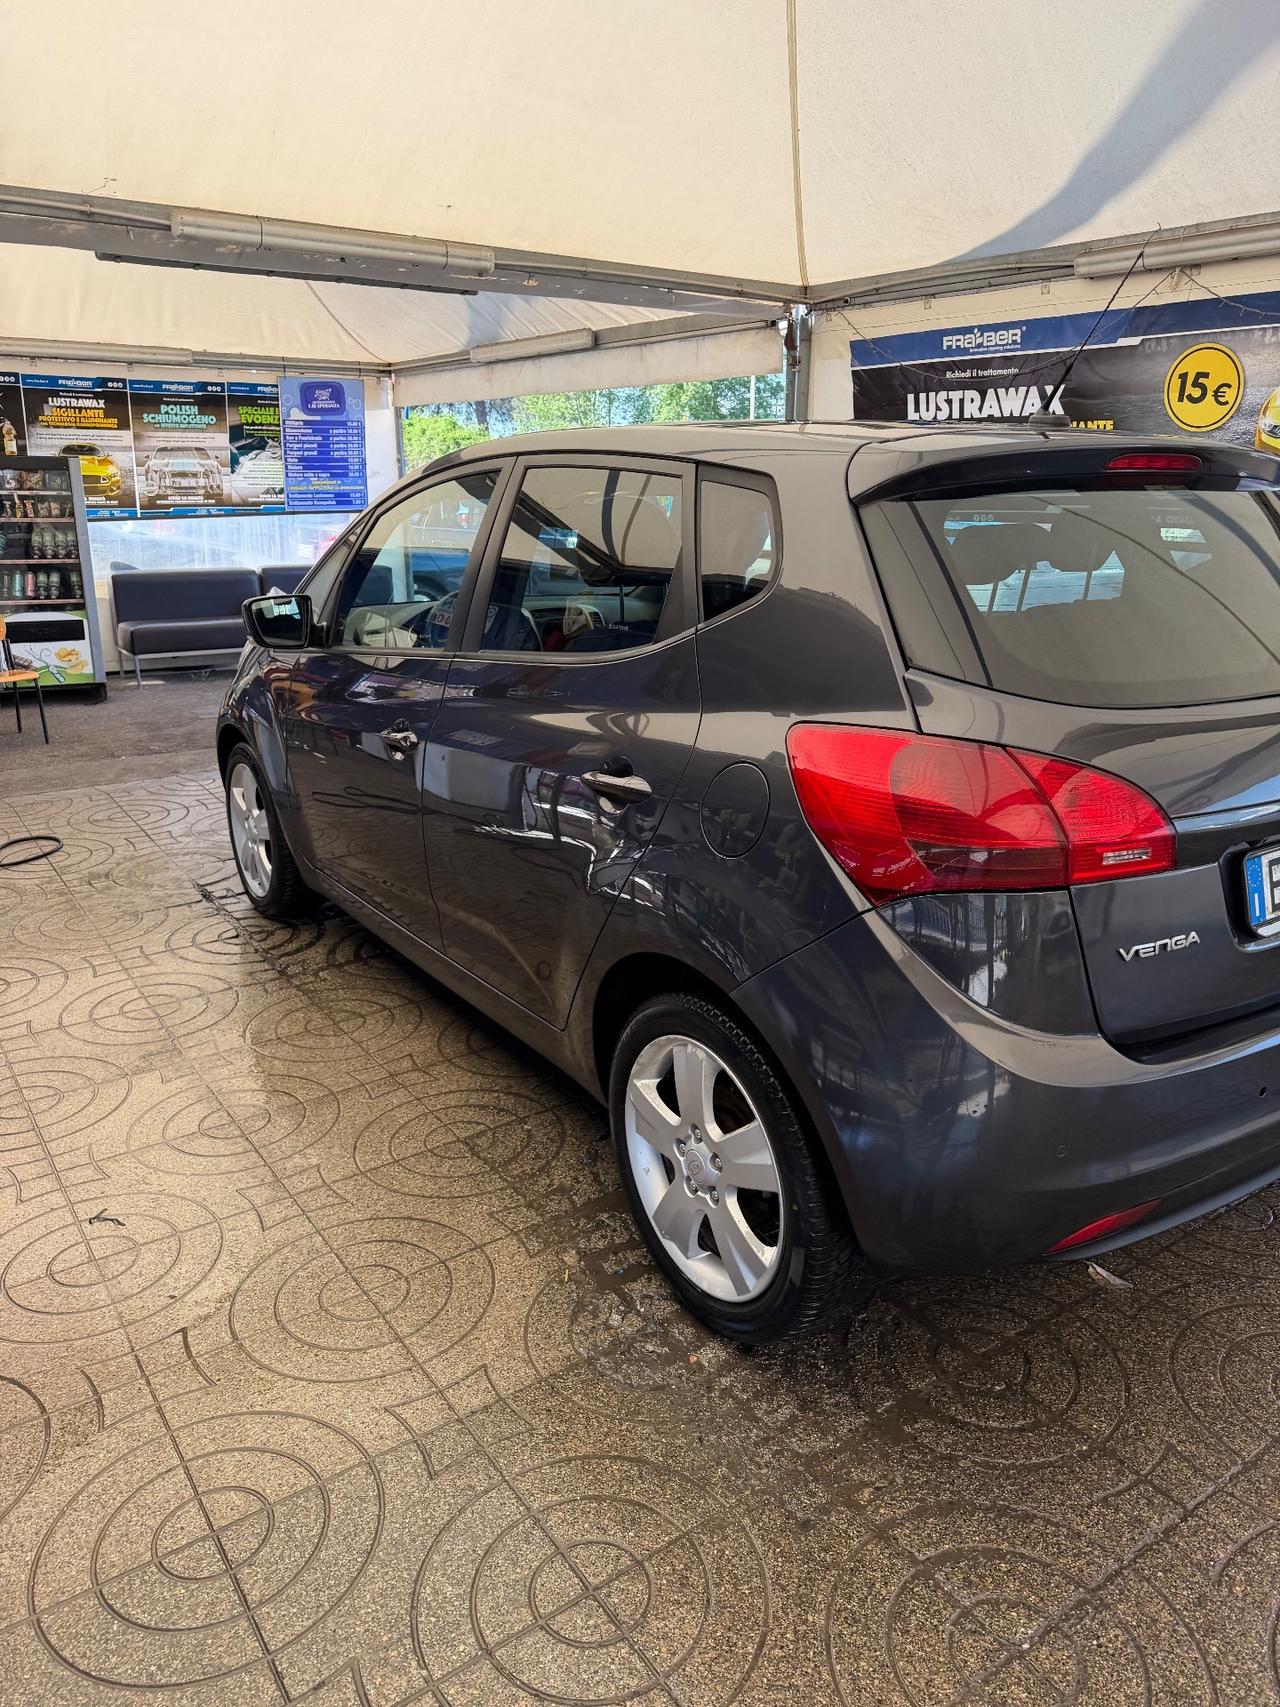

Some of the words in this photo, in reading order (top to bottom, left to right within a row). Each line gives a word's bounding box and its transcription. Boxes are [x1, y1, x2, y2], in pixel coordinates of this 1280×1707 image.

[946, 370, 972, 379] Richiedi
[978, 367, 1019, 377] trattamento
[48, 397, 106, 408] LUSTRAWAX
[906, 383, 1066, 421] LUSTRAWAX
[51, 408, 104, 418] SIGILLANTE
[160, 404, 198, 415] POLISH
[238, 405, 275, 415] SPECIALE
[142, 413, 217, 425] SCHIUMOGENO
[1119, 931, 1201, 962] VENGA
